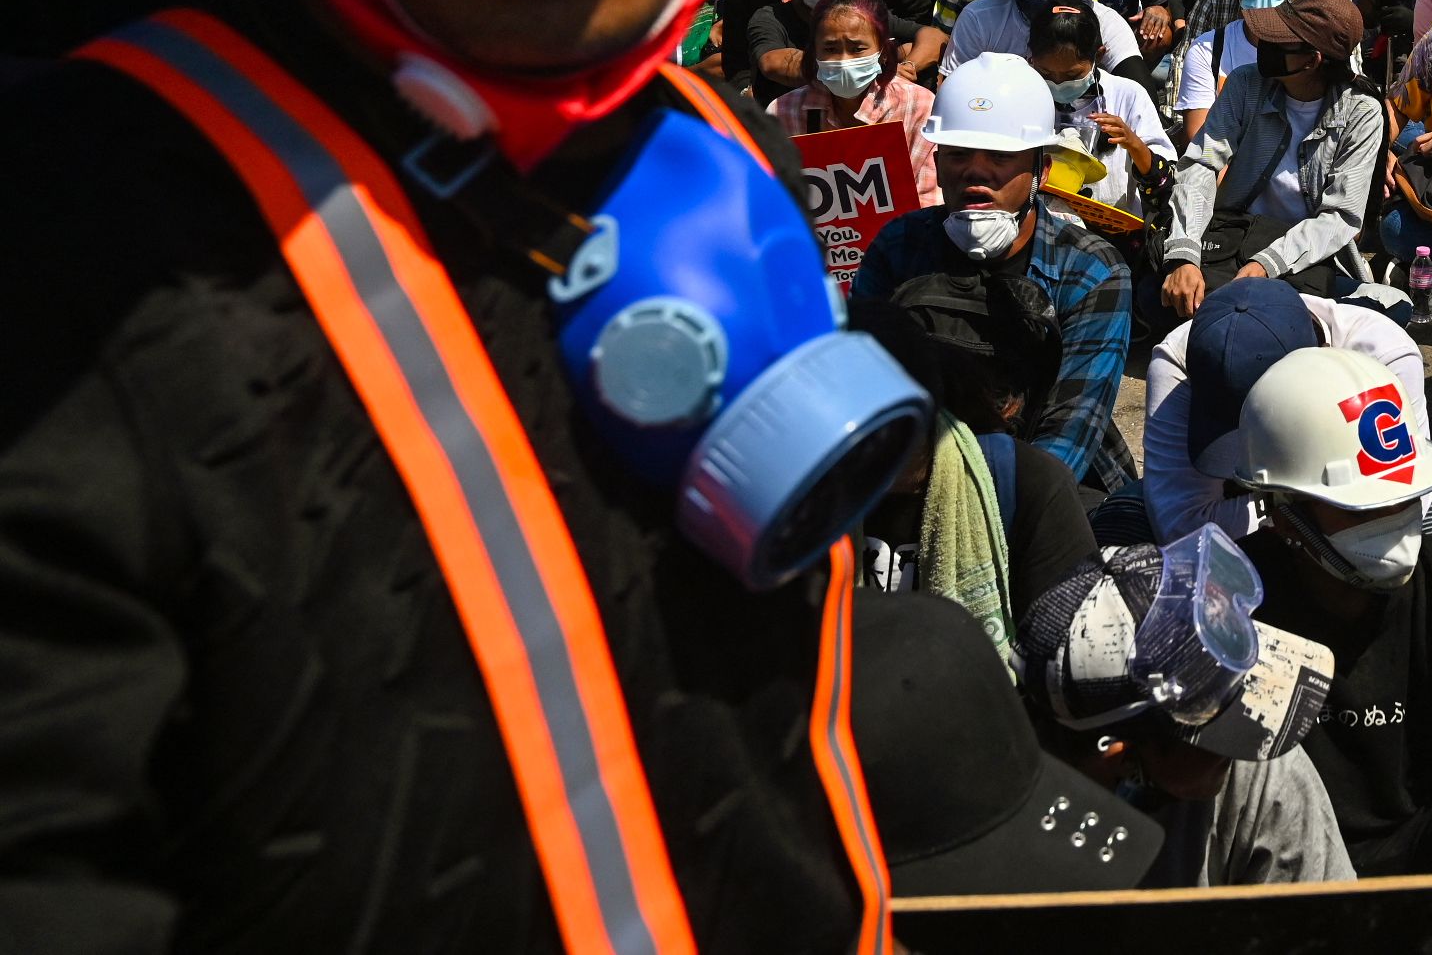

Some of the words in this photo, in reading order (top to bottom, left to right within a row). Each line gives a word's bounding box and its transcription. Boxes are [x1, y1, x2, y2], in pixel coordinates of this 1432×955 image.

[817, 229, 860, 244] You.
[831, 248, 864, 264] Me.
[833, 270, 858, 282] Tog
[1358, 399, 1414, 463] G
